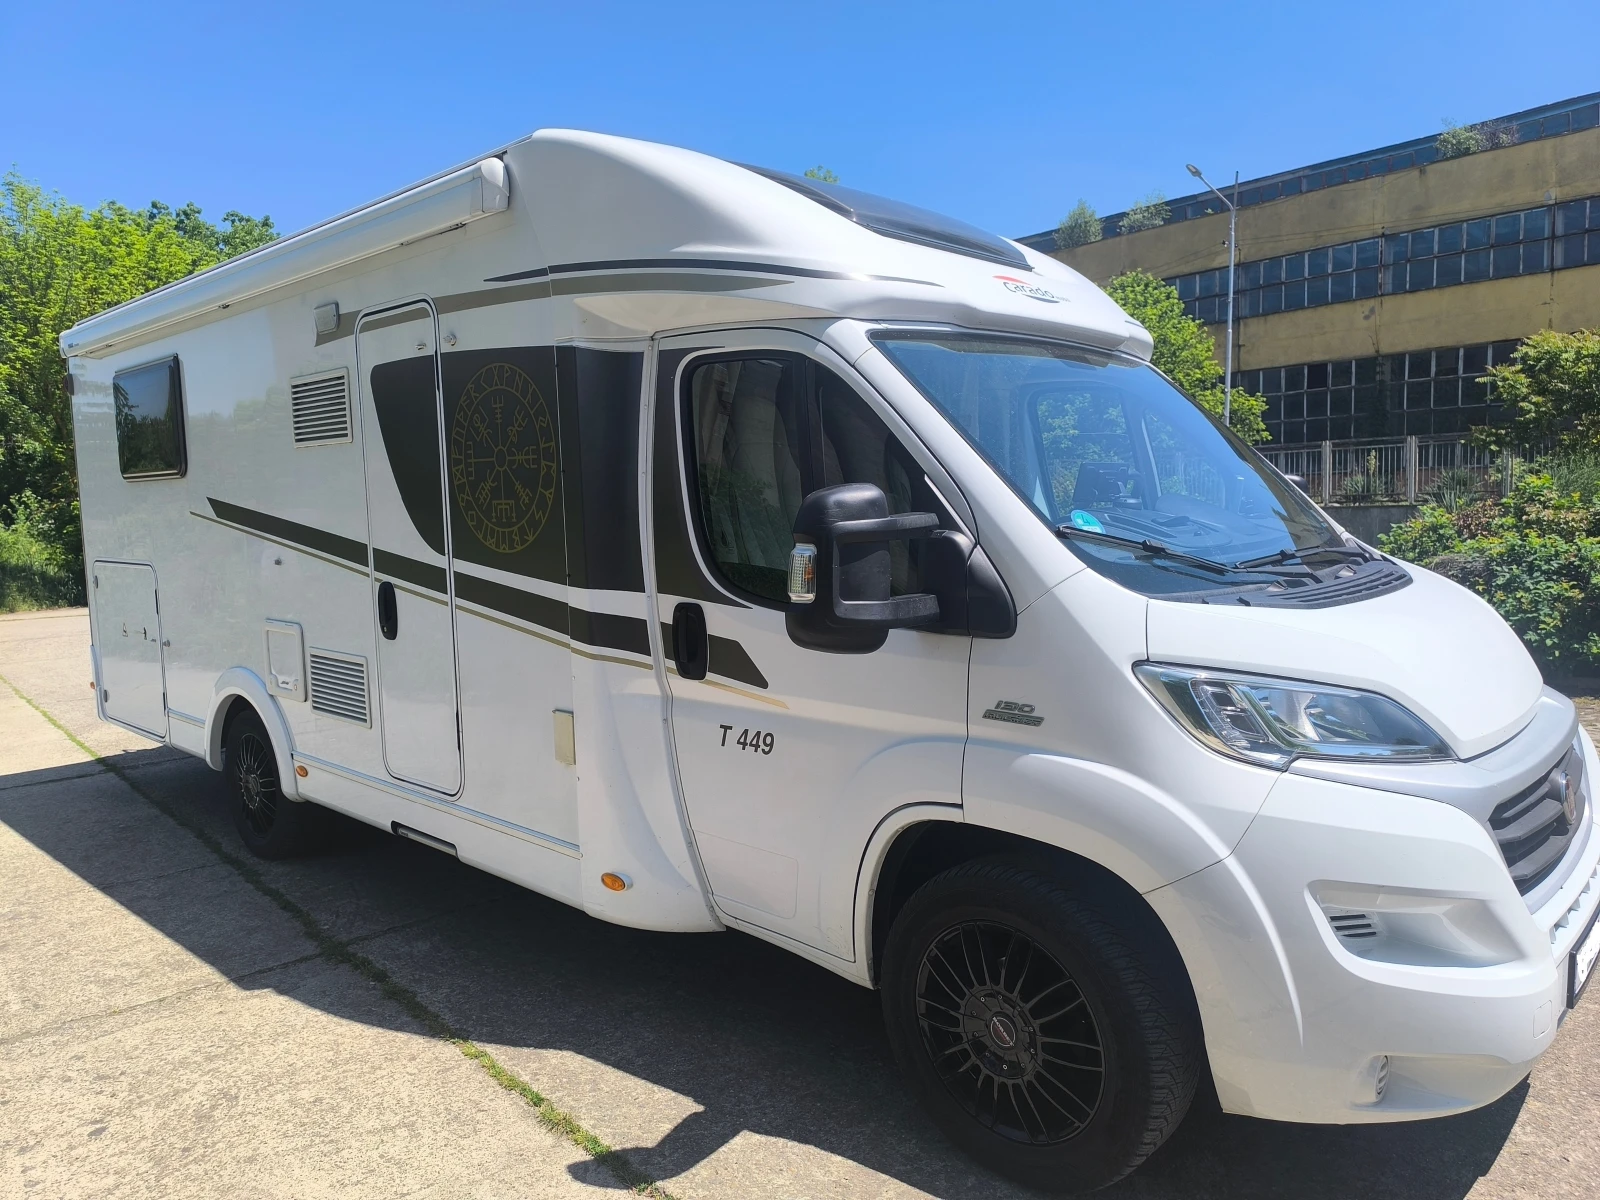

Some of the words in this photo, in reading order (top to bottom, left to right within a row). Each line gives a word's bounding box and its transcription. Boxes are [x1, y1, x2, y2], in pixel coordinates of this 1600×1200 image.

[1003, 281, 1055, 299] Carado
[994, 699, 1036, 714] 130
[719, 724, 733, 747] T
[736, 728, 775, 755] 449
